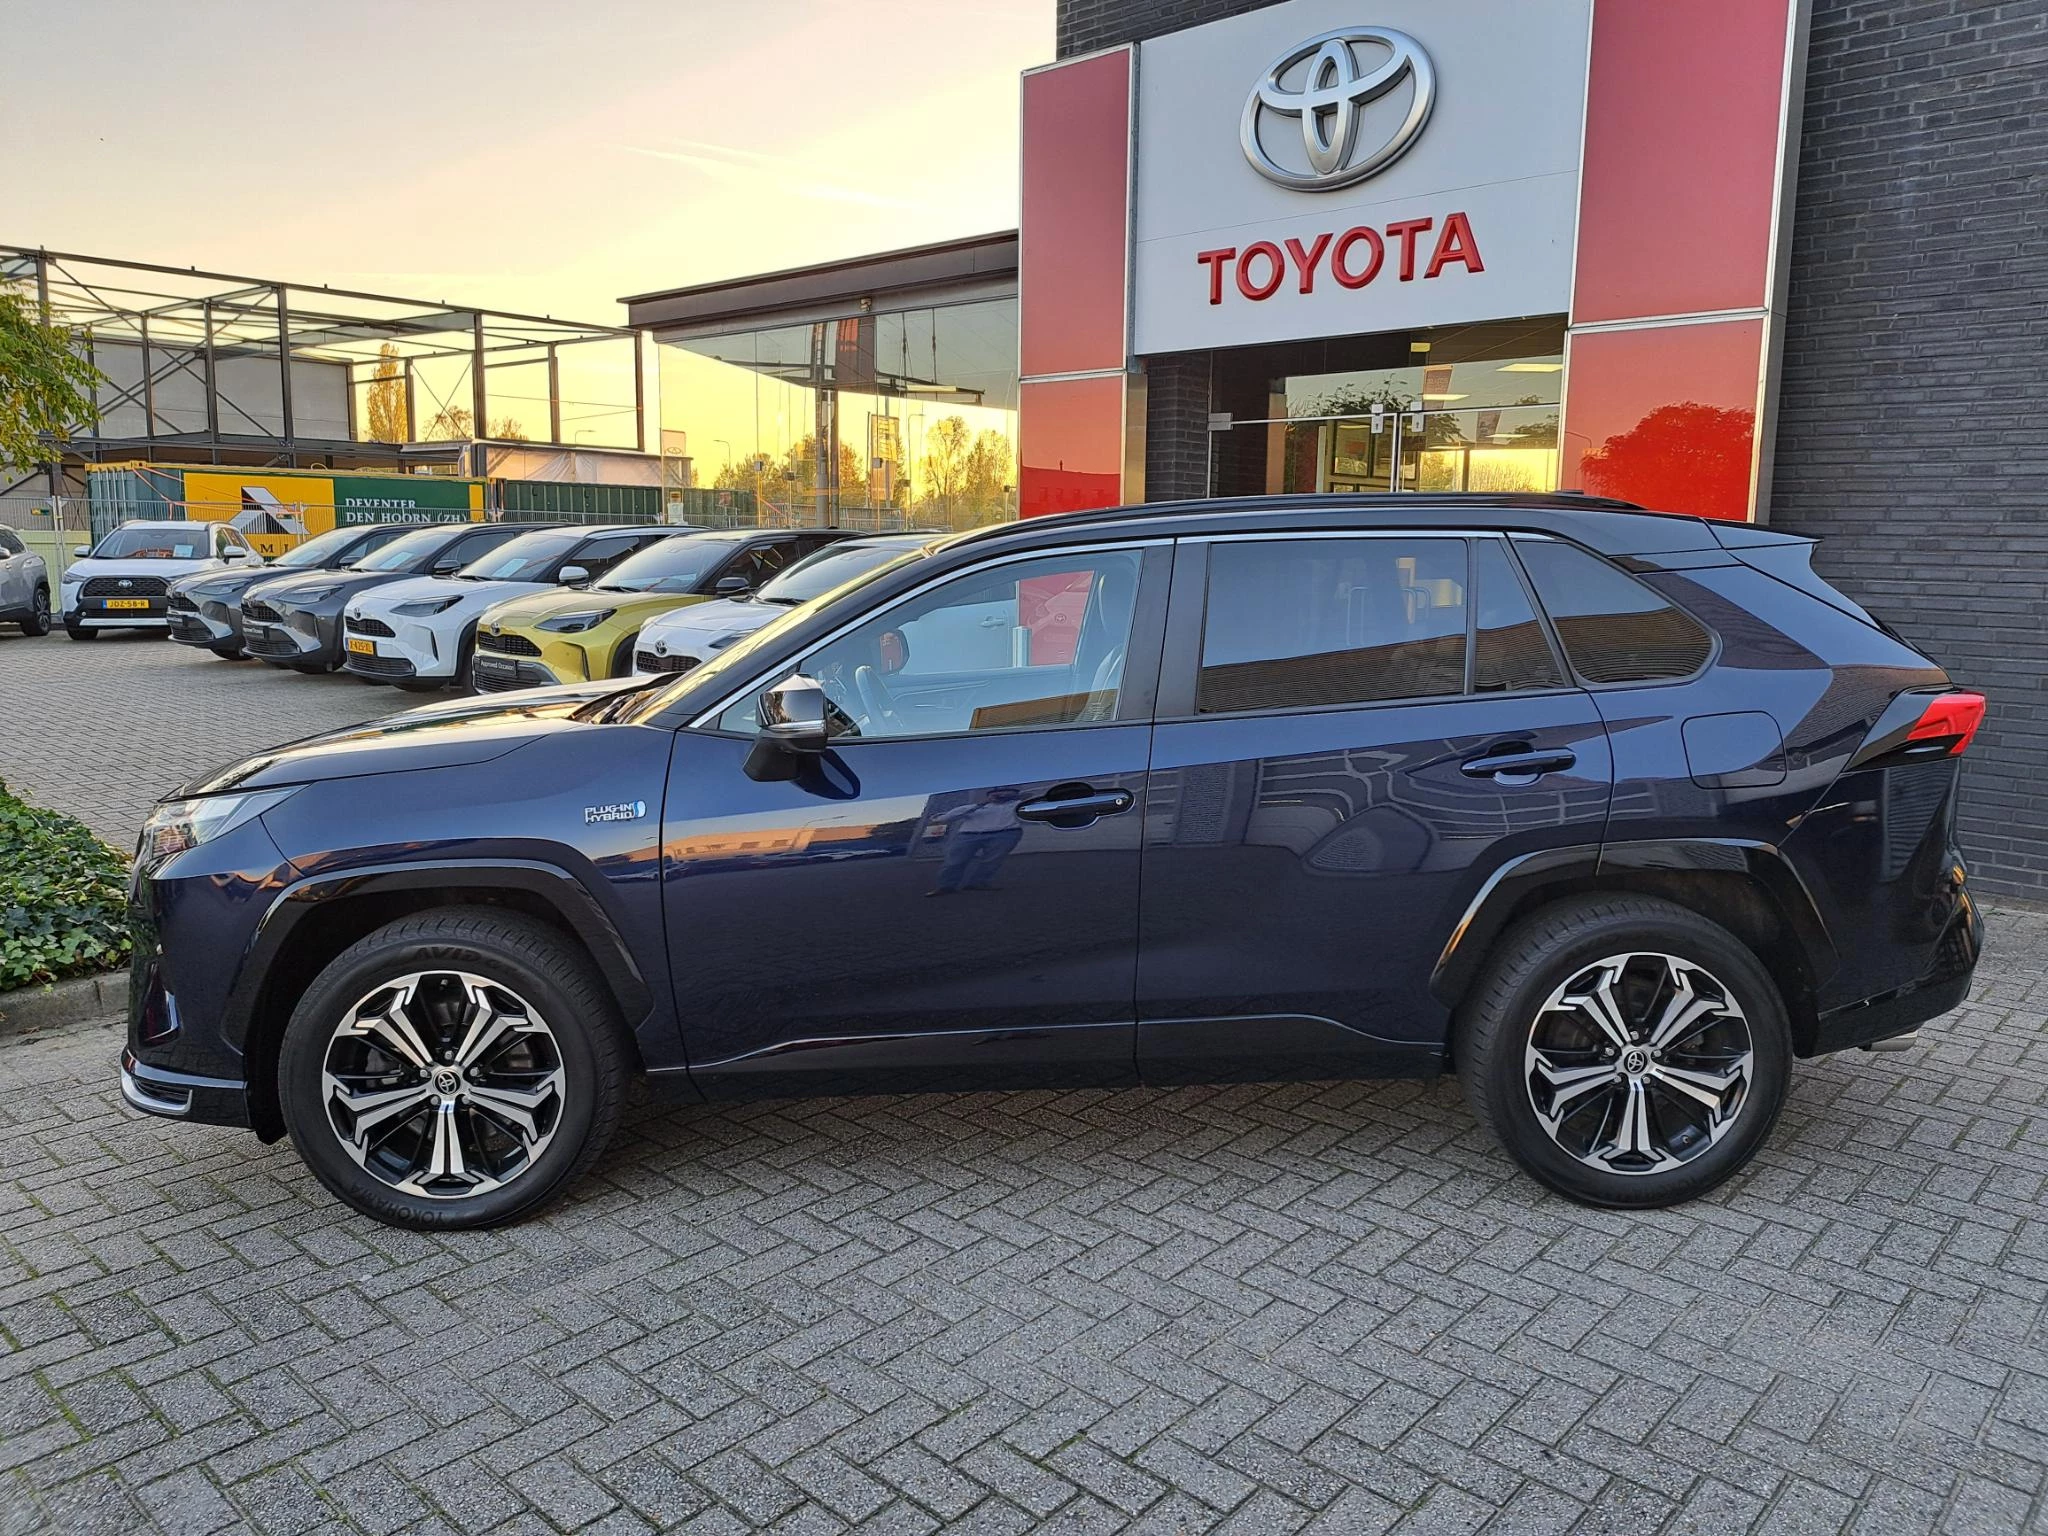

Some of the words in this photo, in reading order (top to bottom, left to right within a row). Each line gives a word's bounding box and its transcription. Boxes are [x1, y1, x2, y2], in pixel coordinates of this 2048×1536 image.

[1198, 211, 1485, 305] TOYOTA
[345, 497, 416, 509] DEVENTER
[346, 512, 374, 523] DEN
[381, 512, 431, 523] HOORN
[584, 810, 632, 823] HYBRID
